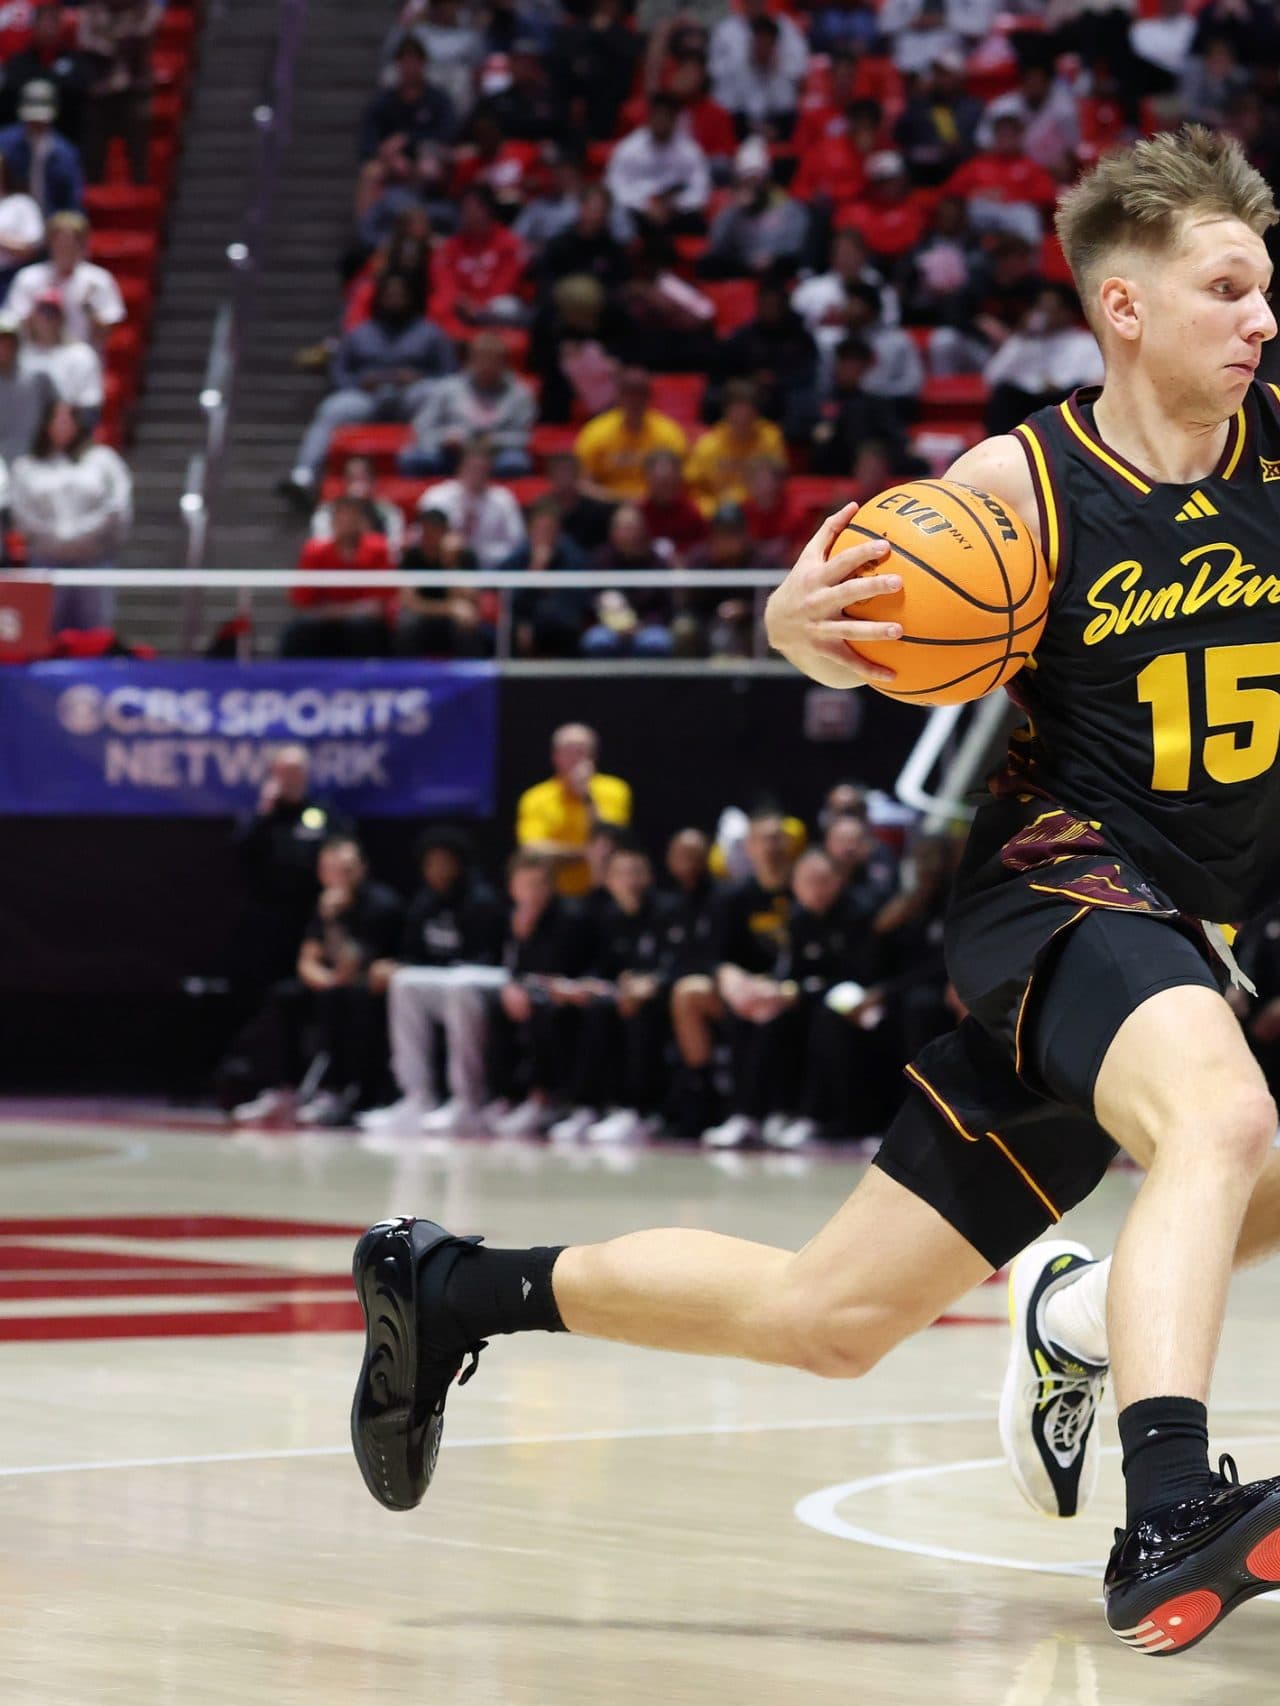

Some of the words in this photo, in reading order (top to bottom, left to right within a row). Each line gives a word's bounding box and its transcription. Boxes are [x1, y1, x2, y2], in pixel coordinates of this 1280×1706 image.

[876, 493, 952, 536] EVO
[107, 687, 214, 735] CBS
[218, 687, 431, 736] SPORTS
[104, 739, 388, 787] NETWRK
